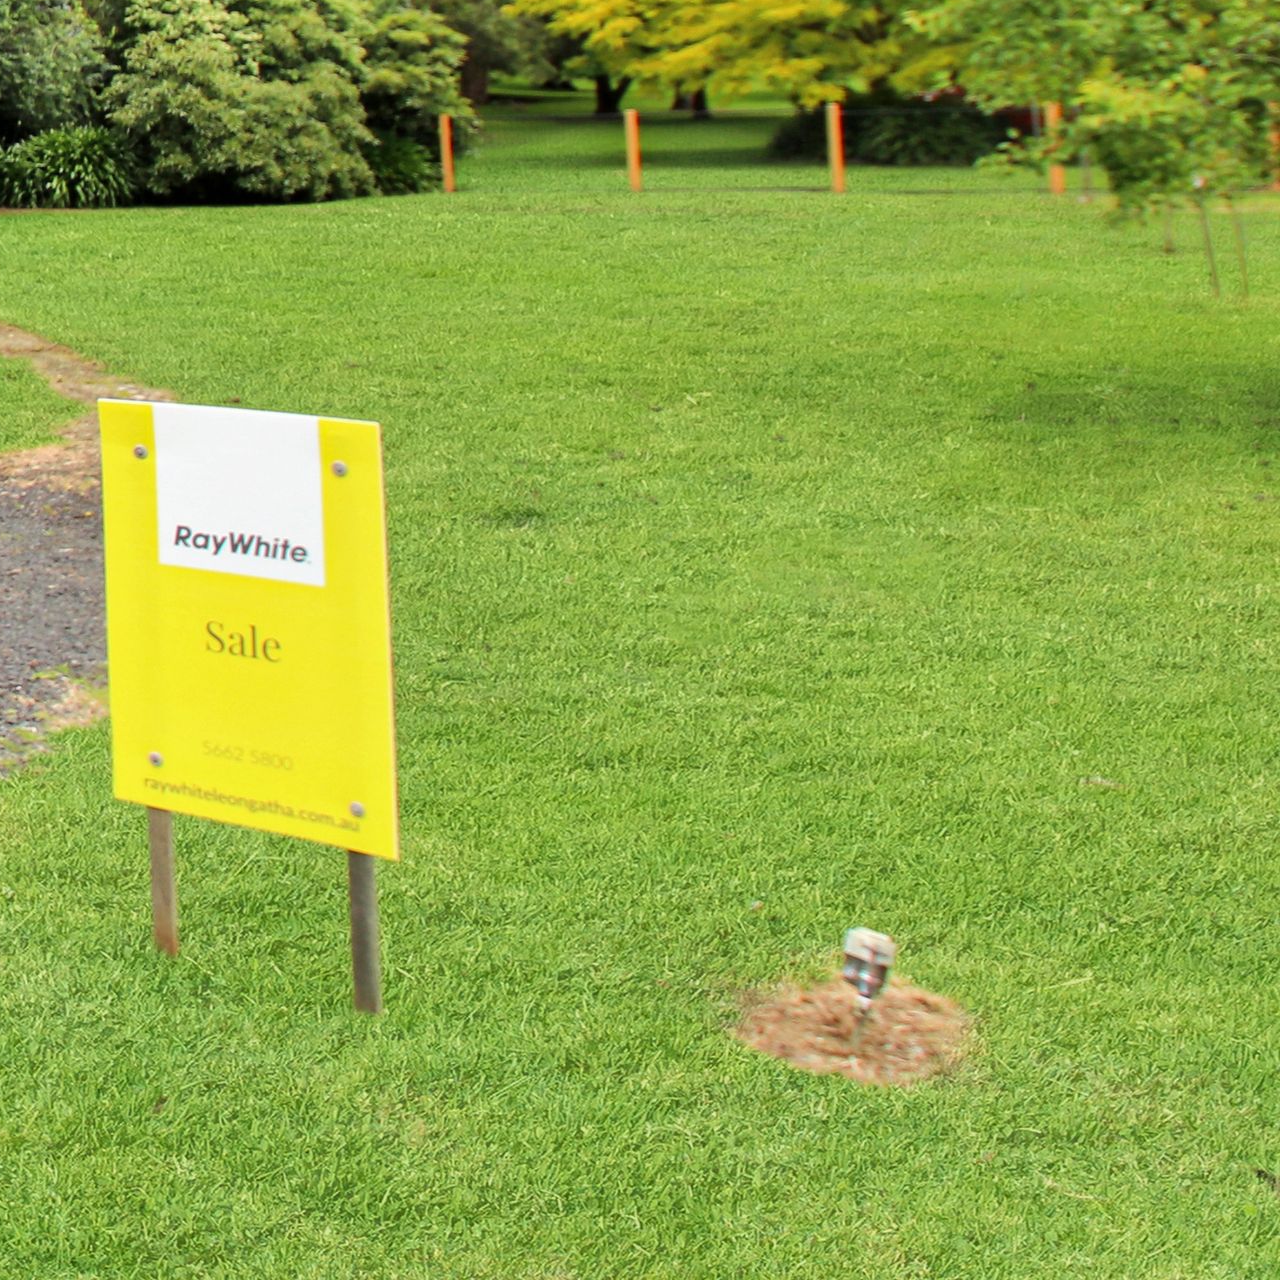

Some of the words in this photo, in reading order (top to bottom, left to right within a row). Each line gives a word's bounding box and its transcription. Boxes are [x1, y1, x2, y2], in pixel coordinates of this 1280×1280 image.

[206, 621, 281, 662] Sale
[202, 739, 244, 763] 5662
[249, 747, 294, 771] 5800
[143, 776, 361, 833] raywhiteleongatha.com.au
